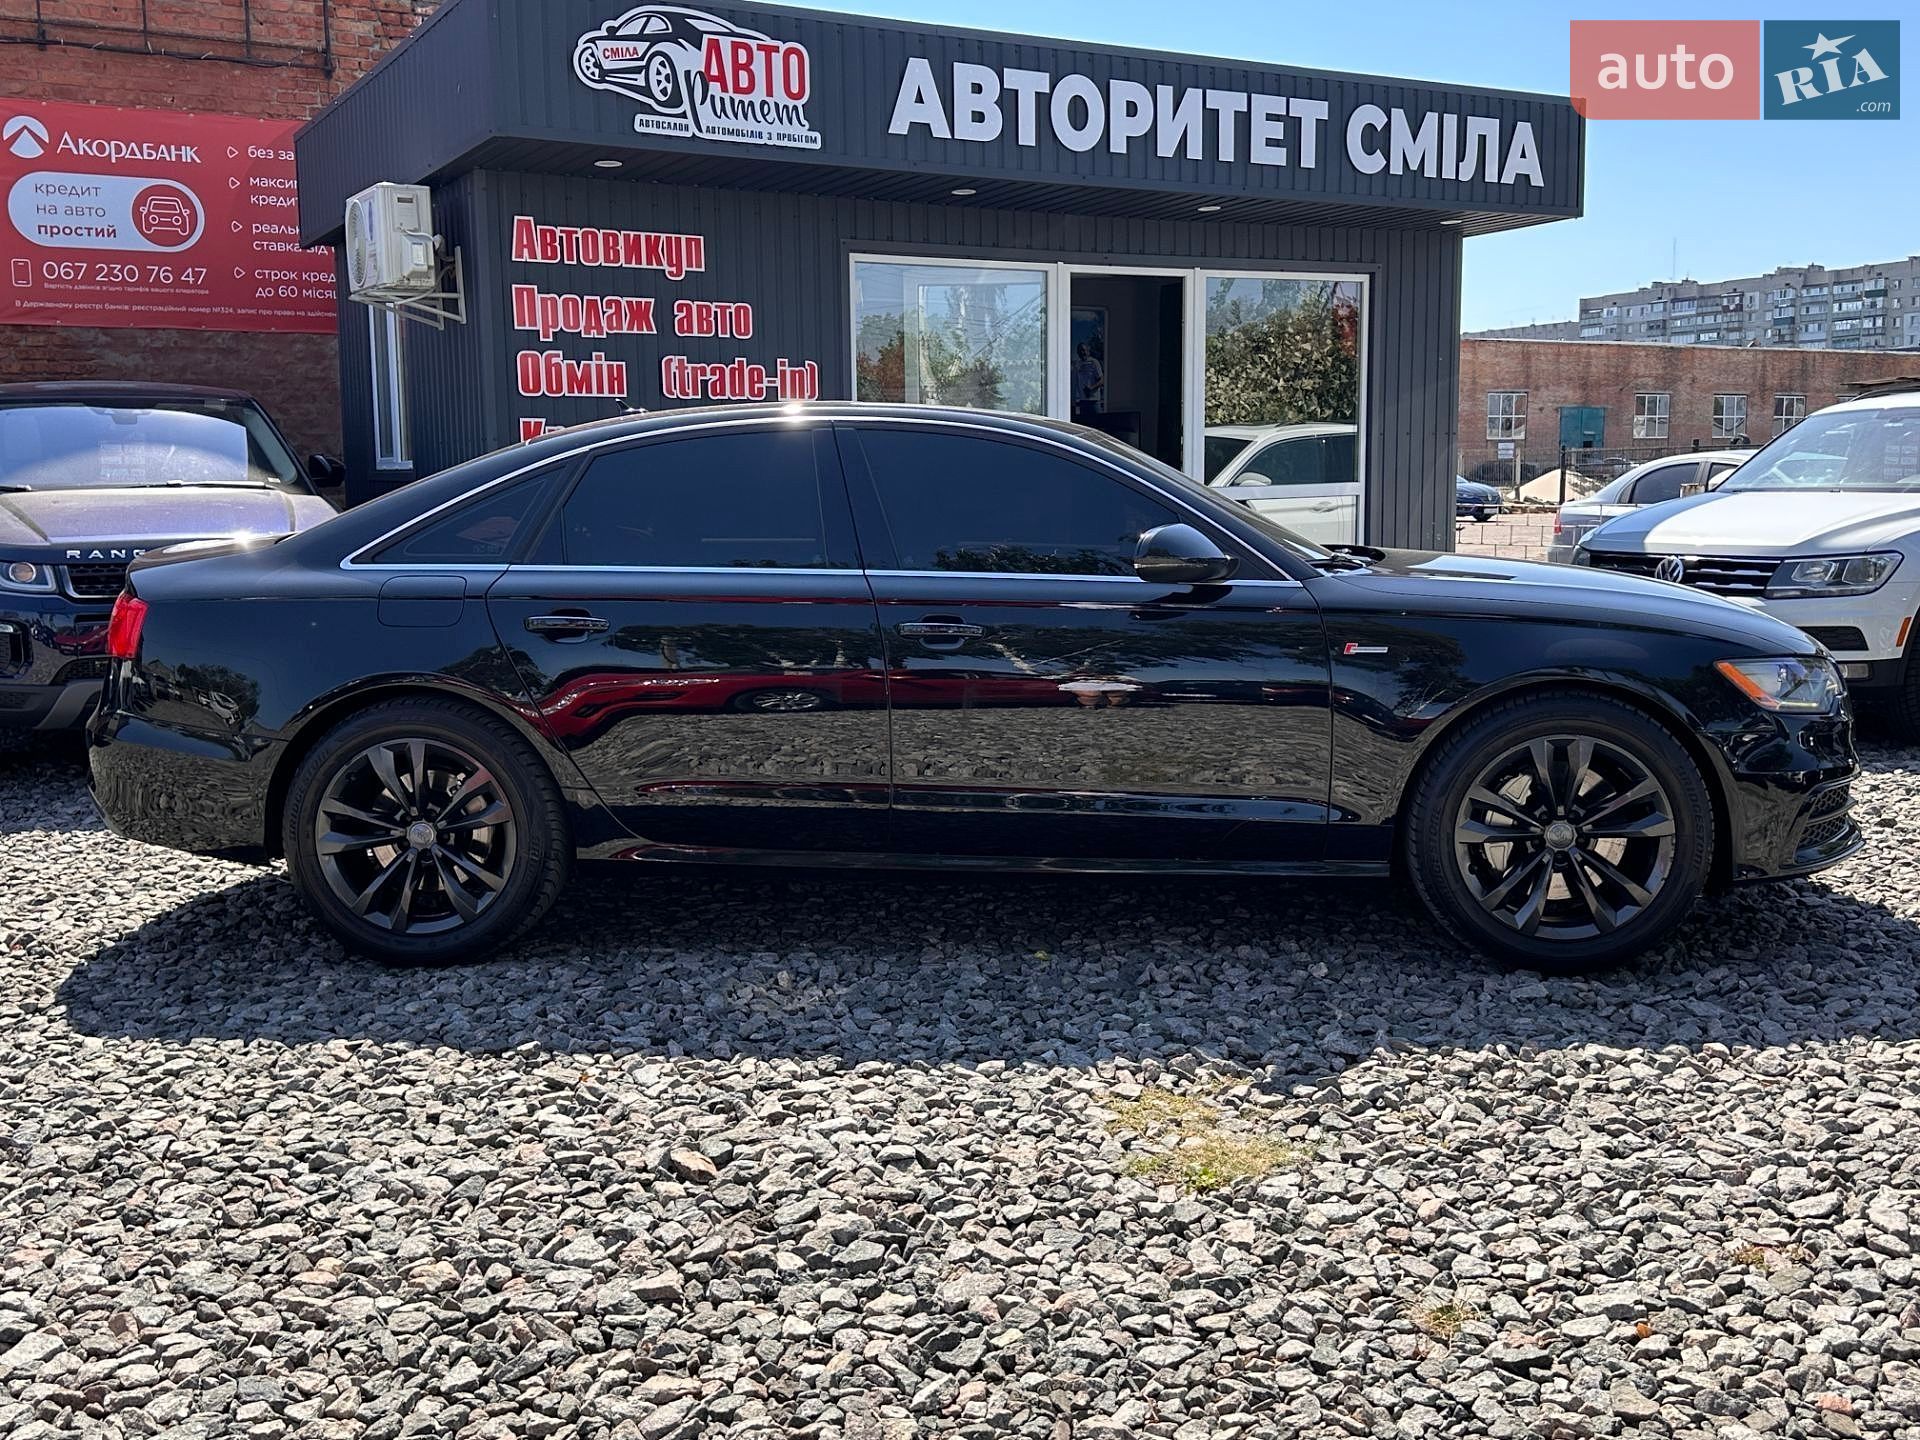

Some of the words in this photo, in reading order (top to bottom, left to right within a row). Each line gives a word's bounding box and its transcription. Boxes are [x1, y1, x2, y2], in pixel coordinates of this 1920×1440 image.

[602, 46, 640, 60] СМІЛА
[703, 37, 806, 101] АВТО
[888, 56, 1329, 169] АВТОРИТЕТ
[1346, 103, 1545, 188] СМІЛА
[638, 118, 690, 132] АВТОСАЛОН
[705, 125, 764, 140] АВТОМОБІЛІВ
[776, 133, 818, 145] ПРОБІГОМ
[248, 145, 274, 160] без
[34, 183, 102, 198] кредит
[251, 194, 298, 208] креди
[36, 204, 58, 216] на
[64, 205, 106, 218] авто
[37, 223, 117, 239] простий
[253, 240, 302, 253] ставка
[512, 215, 705, 280] Автовикуп
[43, 261, 87, 280] 067
[95, 263, 139, 282] 230
[146, 265, 173, 284] 76
[181, 267, 207, 285] 47
[255, 269, 298, 281] строк
[256, 287, 274, 298] до
[278, 286, 298, 297] 60
[512, 284, 657, 342] Продаж
[674, 300, 753, 339] авто
[517, 350, 627, 398] Обмін
[662, 356, 818, 401] (trade-in)
